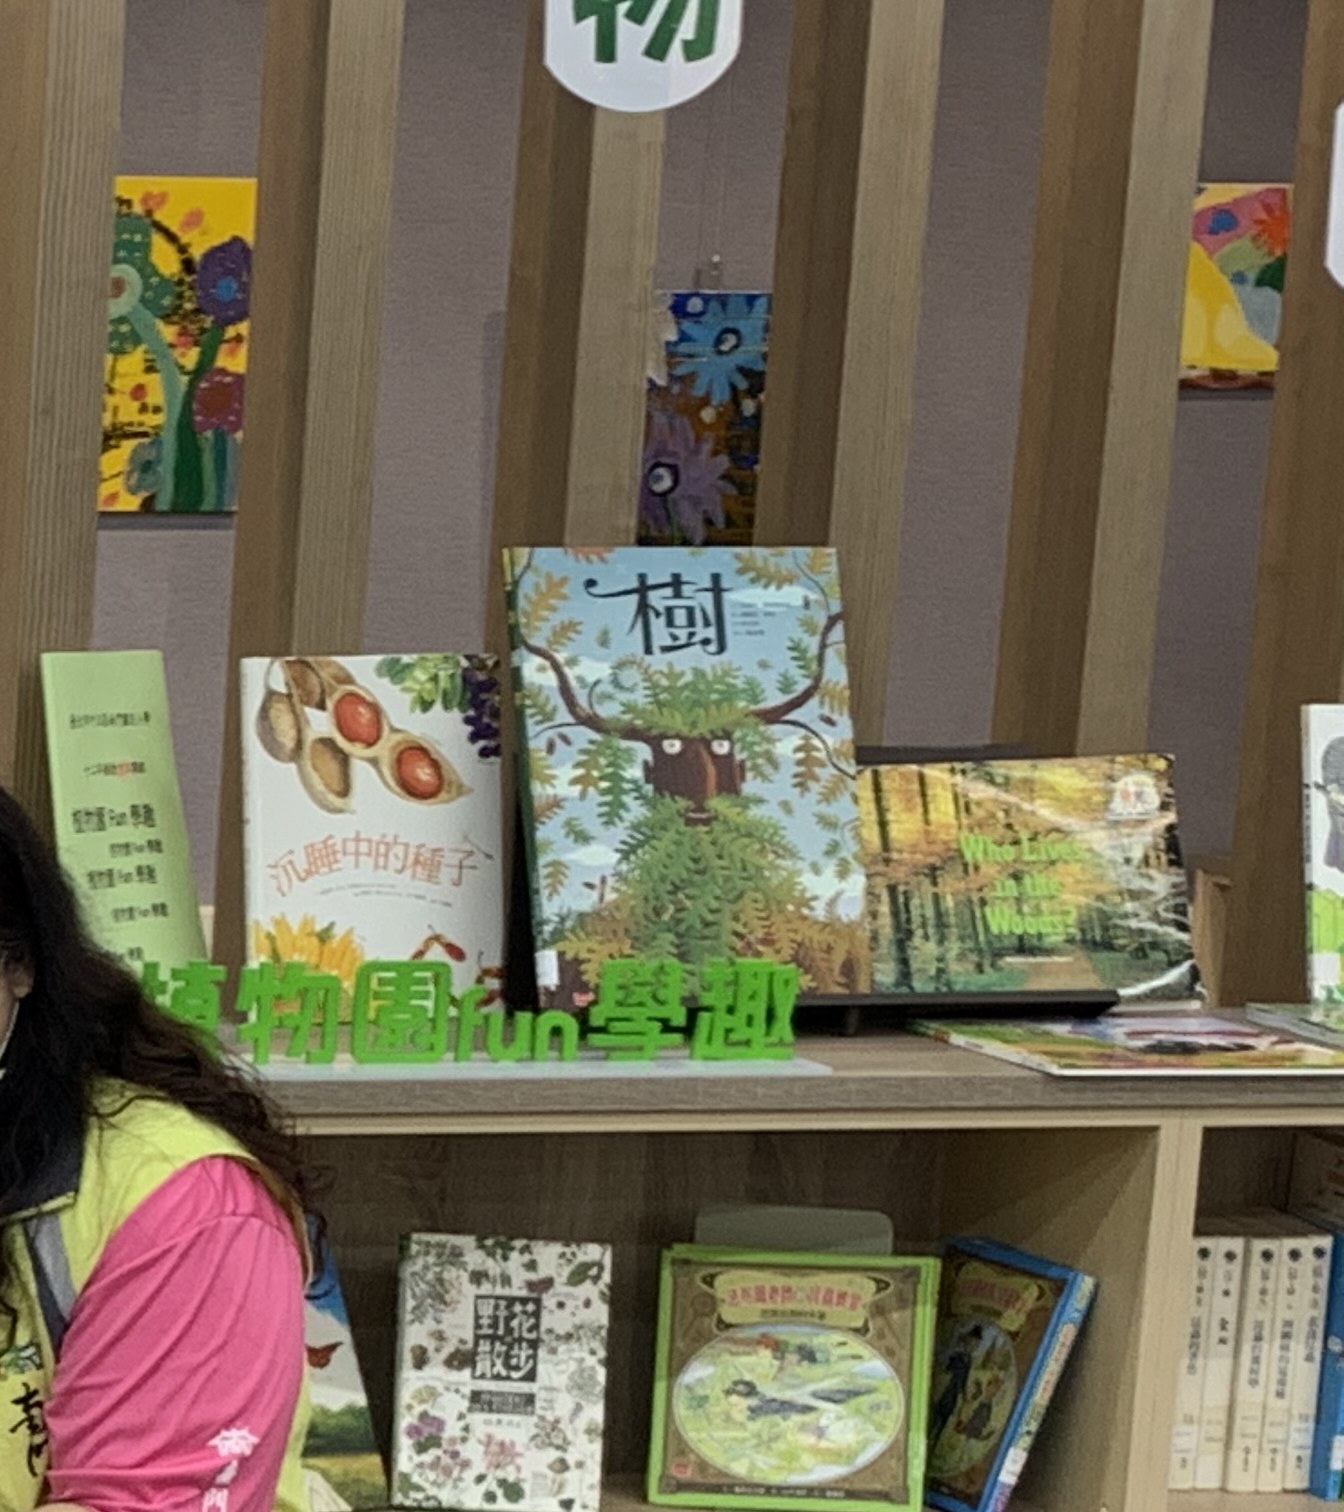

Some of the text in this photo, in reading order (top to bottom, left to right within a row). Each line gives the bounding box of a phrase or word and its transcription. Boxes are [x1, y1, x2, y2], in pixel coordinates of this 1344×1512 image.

[584, 573, 734, 655] 樹
[266, 830, 478, 897] 沉睡中的種子
[475, 1298, 537, 1340] 野花
[474, 1339, 534, 1379] 散步
